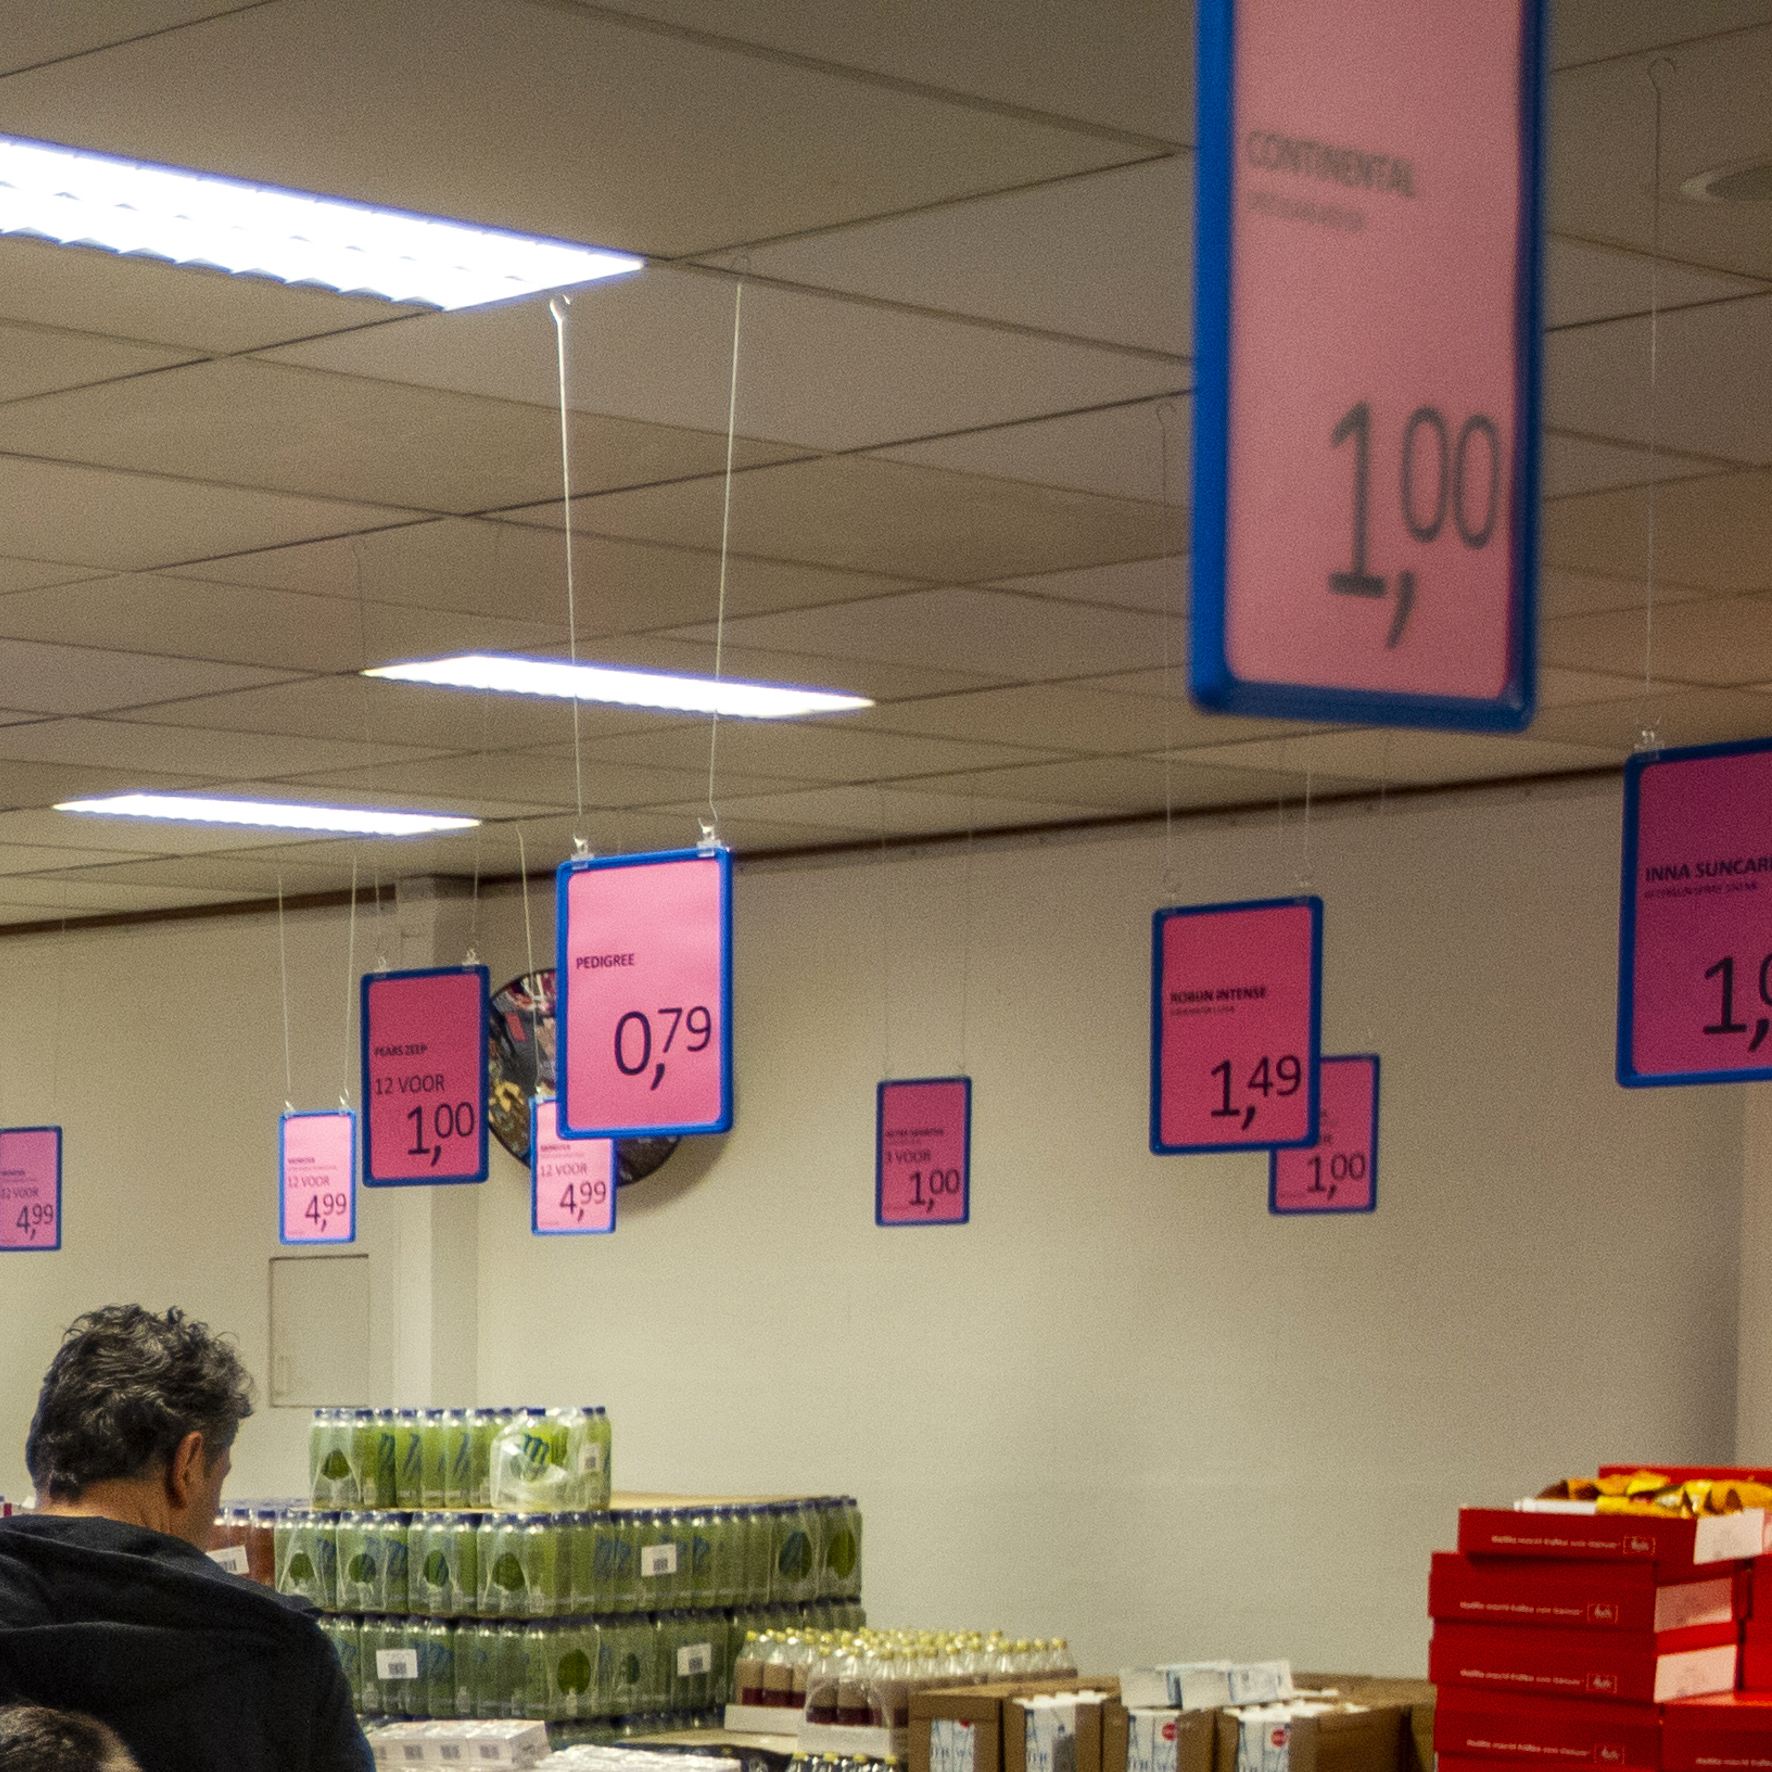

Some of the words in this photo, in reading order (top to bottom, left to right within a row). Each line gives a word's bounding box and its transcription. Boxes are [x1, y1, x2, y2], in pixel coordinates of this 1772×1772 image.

[1329, 401, 1500, 650] 1,00
[1644, 864, 1691, 882] INNA
[576, 953, 635, 969] PEDIGREE
[1216, 986, 1267, 1001] INTENSE
[613, 1006, 712, 1091] 0,79
[374, 1077, 393, 1095] 12
[397, 1074, 445, 1093] VOOR
[1210, 1055, 1302, 1131] 1,49
[406, 1101, 475, 1166] 1,00
[540, 1165, 553, 1177] 12
[555, 1162, 588, 1176] VOOR
[895, 1149, 931, 1165] VOOR
[13, 1186, 39, 1199] VOOR
[288, 1178, 298, 1189] 12
[301, 1176, 330, 1188] VOOR
[908, 1169, 960, 1213] 1,00
[1307, 1153, 1366, 1200] 1,00
[304, 1193, 347, 1232] 4,99
[559, 1180, 607, 1222] 4,99
[16, 1203, 54, 1240] 4,99
